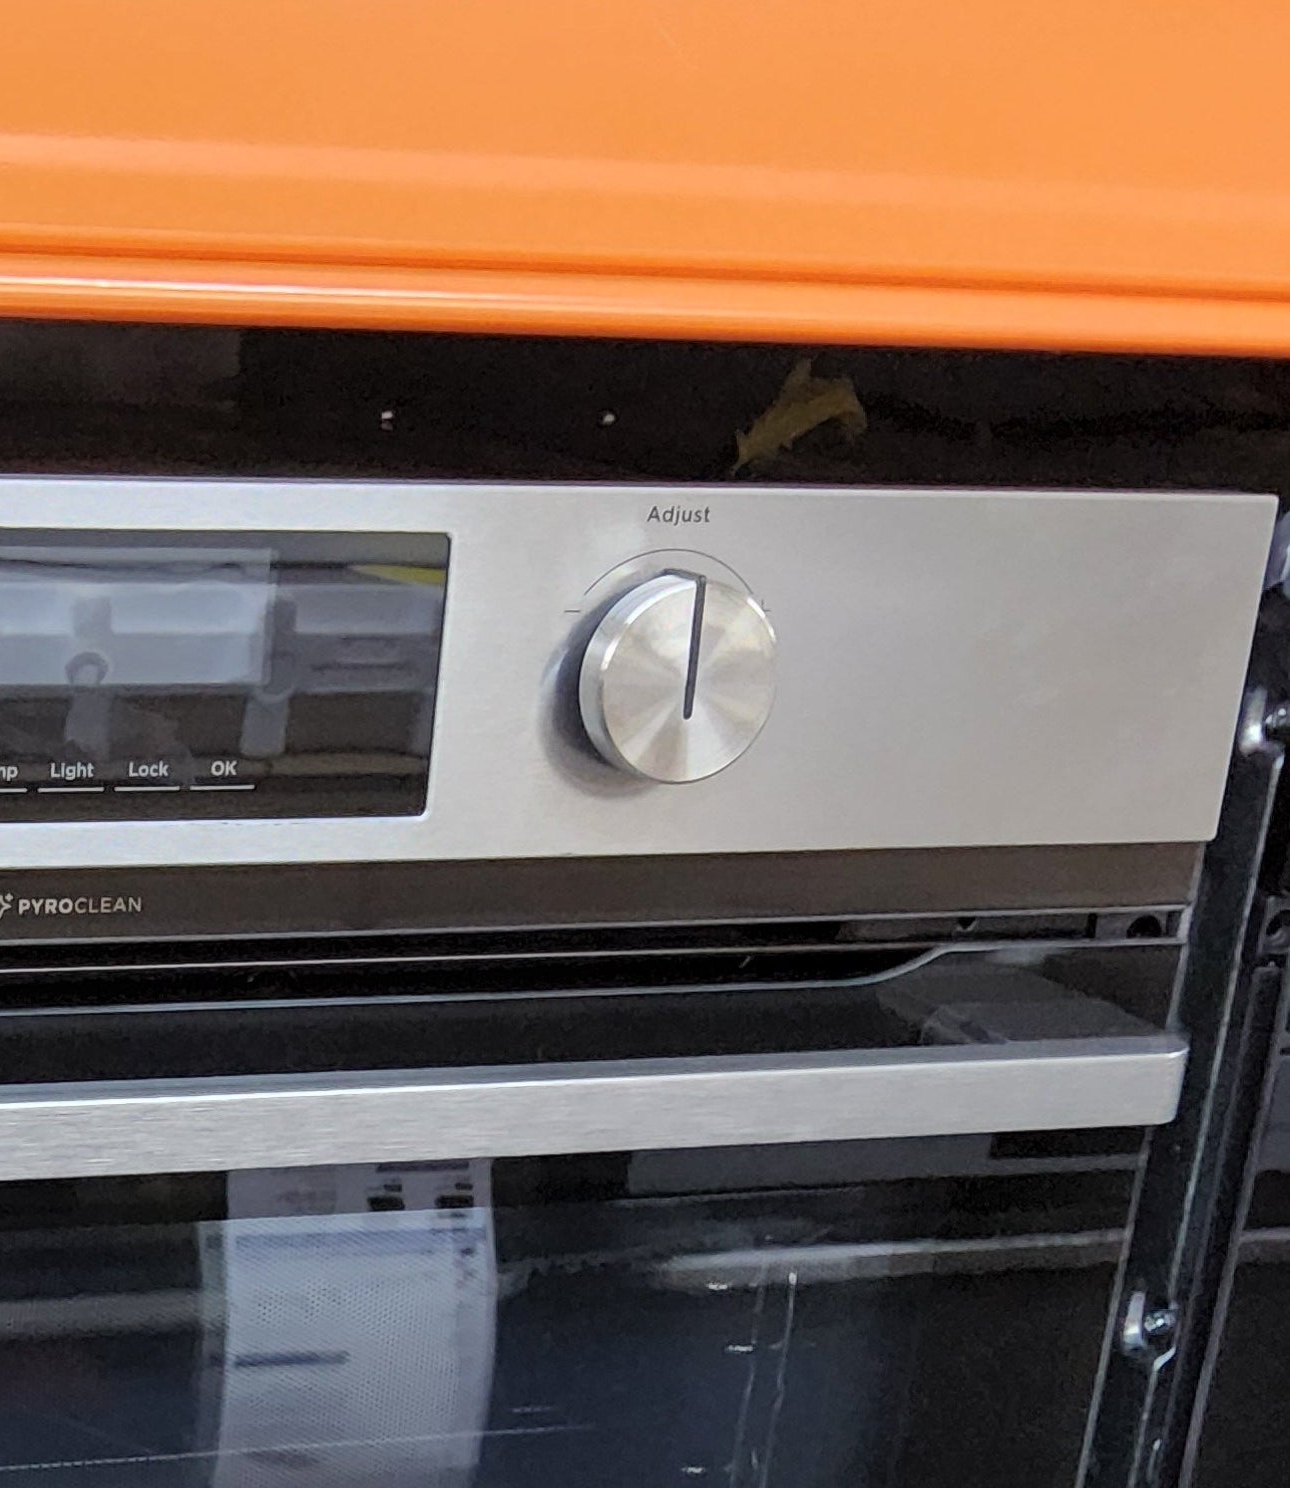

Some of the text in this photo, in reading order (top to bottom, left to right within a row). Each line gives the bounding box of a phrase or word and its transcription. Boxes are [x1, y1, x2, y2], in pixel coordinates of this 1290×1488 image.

[646, 505, 711, 526] Adjust
[50, 761, 94, 781] Light
[128, 761, 169, 778] Lock
[211, 760, 237, 776] OK
[18, 897, 142, 915] PYROCLEAN
